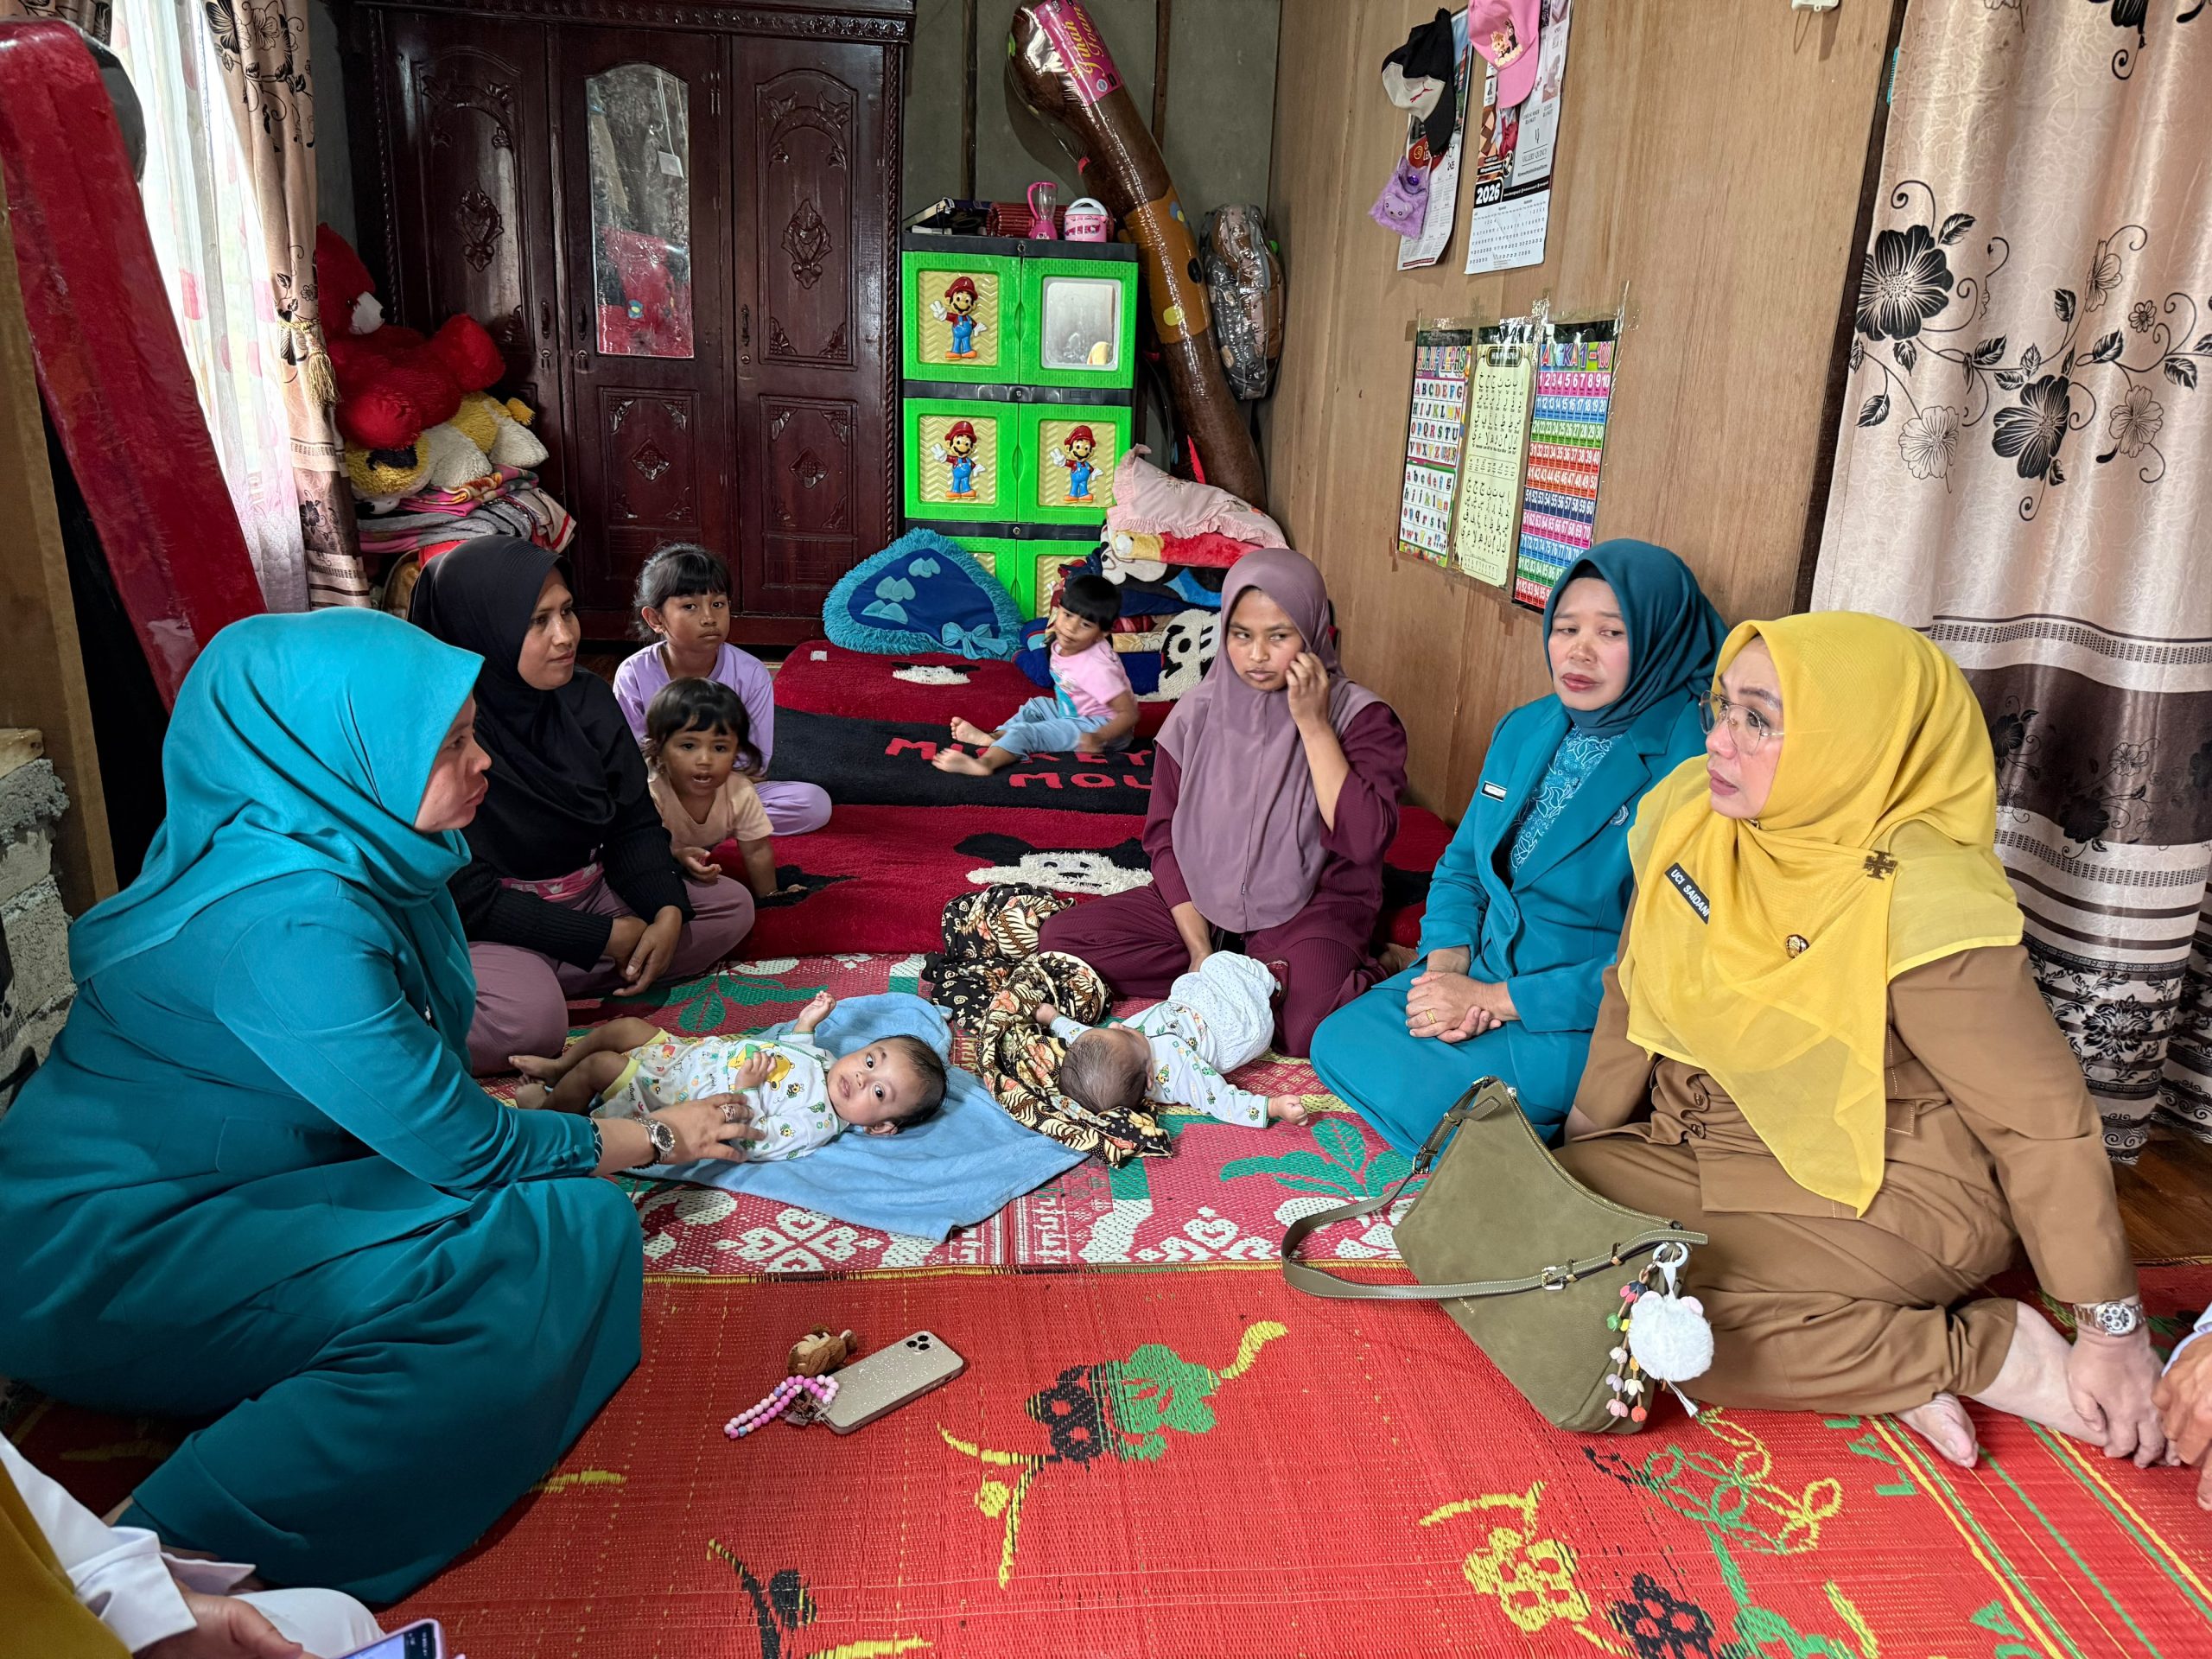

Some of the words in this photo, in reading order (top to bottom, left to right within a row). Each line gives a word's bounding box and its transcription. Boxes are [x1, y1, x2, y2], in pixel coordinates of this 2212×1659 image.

[1074, 6, 1104, 57] Foam
[1476, 183, 1500, 204] 2026
[1440, 346, 1466, 373] LEPAS
[1541, 343, 1578, 366] ANGKA
[1415, 383, 1420, 396] A
[1422, 383, 1427, 394] B
[1429, 386, 1433, 396] C
[1435, 384, 1440, 397] D
[1442, 385, 1447, 398] E
[1457, 386, 1462, 398] G
[1544, 373, 1550, 386] 2
[1552, 373, 1556, 386] 3
[1557, 373, 1562, 386] 4
[1565, 373, 1571, 386] 5
[1573, 373, 1578, 387] 6
[1580, 373, 1585, 387] 7
[1587, 373, 1593, 387] 8
[1596, 373, 1601, 387] 9
[1602, 374, 1610, 387] 10
[1413, 403, 1417, 414] H
[1419, 404, 1424, 416] I
[1426, 404, 1431, 416] J
[1433, 404, 1439, 417] K
[1440, 405, 1445, 417] L
[1455, 407, 1460, 421] N
[1535, 396, 1541, 408] 11
[1542, 396, 1548, 408] 12
[1549, 397, 1554, 409] 13
[1555, 397, 1560, 409] 14
[1562, 397, 1568, 409] 15
[1569, 398, 1575, 410] 16
[1577, 398, 1583, 410] 17
[1585, 399, 1591, 411] 18
[1592, 399, 1598, 411] 19
[1599, 399, 1606, 412] 20
[1411, 421, 1415, 434] O
[1424, 423, 1428, 437] Q
[1430, 425, 1435, 438] R
[1438, 426, 1442, 440] S
[1445, 428, 1450, 440] T
[1452, 428, 1458, 440] U
[1410, 442, 1415, 454] V
[1422, 443, 1427, 456] X
[1435, 446, 1440, 458] Z
[1530, 443, 1537, 455] 31
[1537, 444, 1543, 456] 32
[1543, 445, 1549, 457] 33
[1549, 446, 1556, 458] 34
[1556, 446, 1563, 459] 35
[1563, 447, 1570, 460] 36
[1570, 448, 1577, 461] 37
[1578, 449, 1585, 462] 38
[1585, 450, 1592, 463] 39
[1592, 451, 1600, 464] 40
[1525, 489, 1531, 501] 51
[1531, 490, 1538, 503] 52
[1538, 491, 1544, 504] 53
[1544, 492, 1550, 505] 54
[1551, 493, 1557, 507] 55
[1557, 495, 1564, 508] 56
[1564, 496, 1572, 509] 57
[1571, 498, 1578, 511] 58
[1579, 499, 1586, 512] 59
[1586, 501, 1594, 514] 60
[1523, 512, 1529, 523] 61
[1529, 513, 1535, 525] 62
[1535, 514, 1541, 527] 63
[1541, 516, 1548, 528] 64
[1548, 517, 1554, 530] 65
[1555, 519, 1561, 532] 66
[1561, 520, 1568, 533] 67
[1568, 522, 1575, 535] 68
[1575, 524, 1582, 537] 69
[1583, 525, 1590, 539] 70
[885, 737, 1152, 766] MKEY
[1671, 869, 1685, 885] UCI
[1683, 885, 1710, 917] SAIDANI
